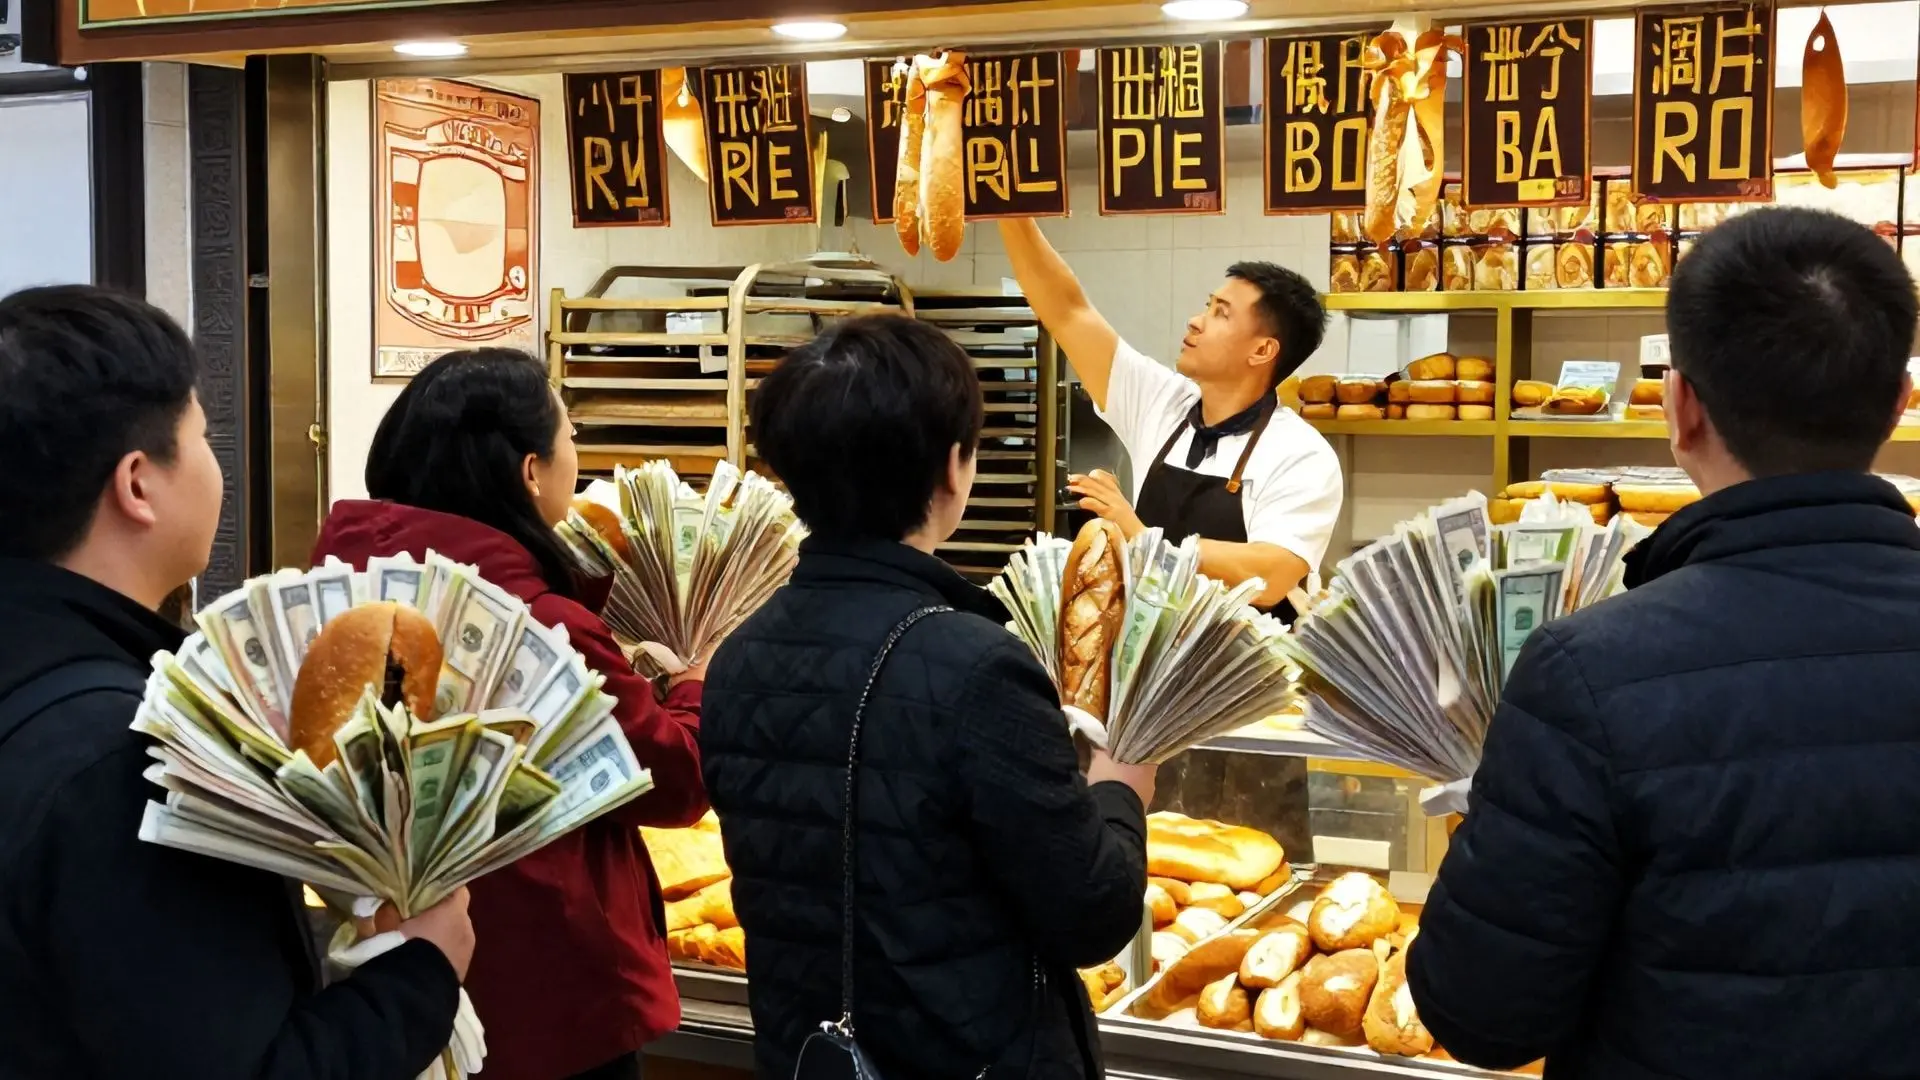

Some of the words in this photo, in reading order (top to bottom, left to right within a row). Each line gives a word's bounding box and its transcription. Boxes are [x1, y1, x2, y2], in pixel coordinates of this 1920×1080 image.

[1112, 123, 1207, 197] PIE
[1285, 117, 1367, 193] BO
[1496, 107, 1562, 183] BA
[1652, 97, 1753, 183] RO
